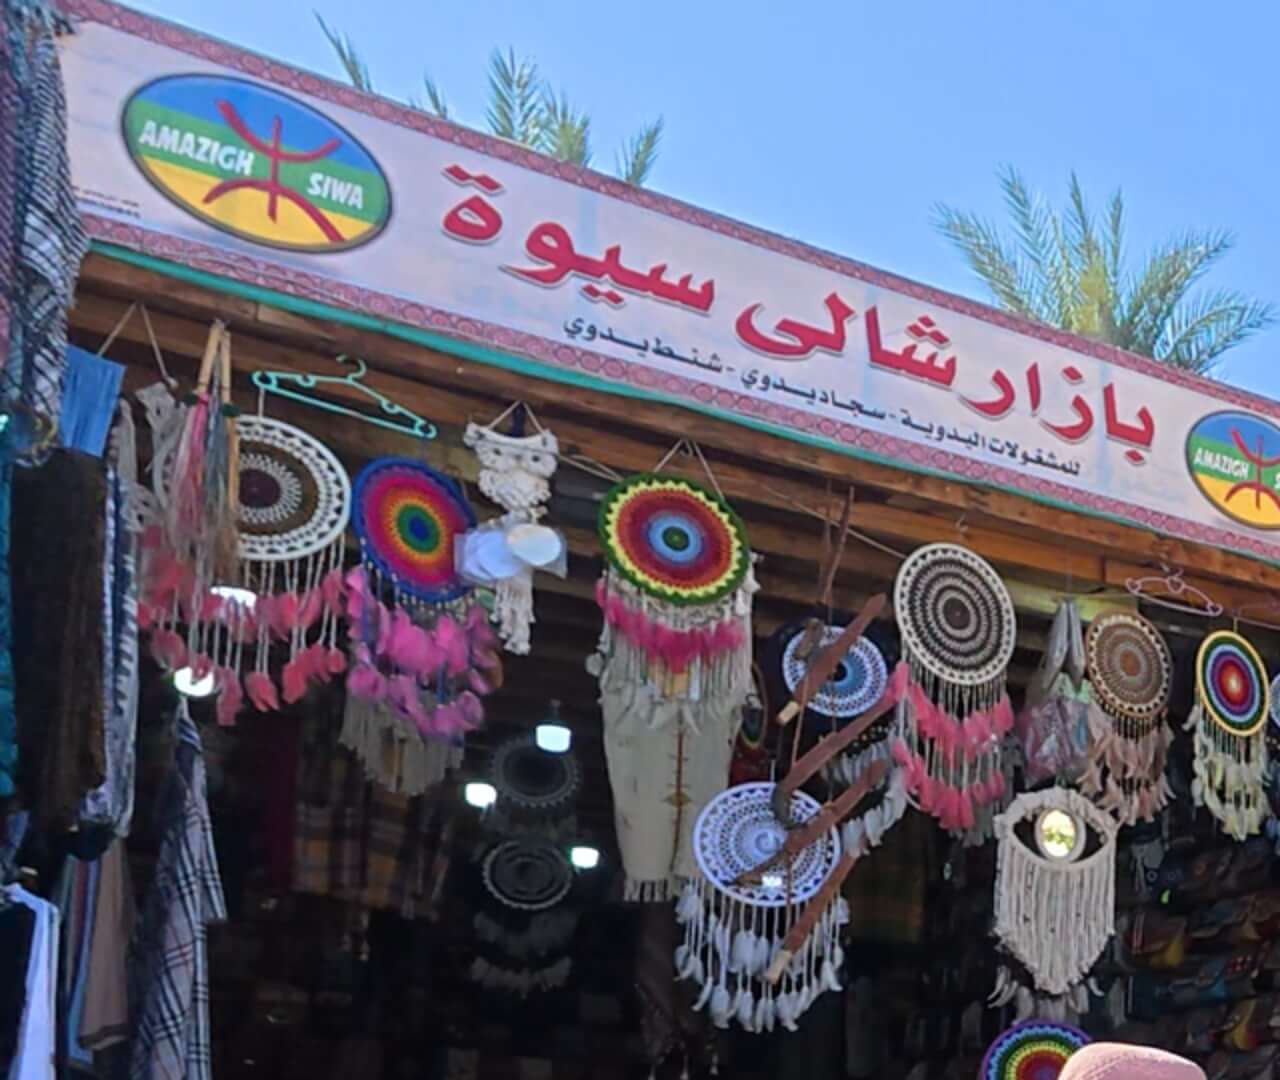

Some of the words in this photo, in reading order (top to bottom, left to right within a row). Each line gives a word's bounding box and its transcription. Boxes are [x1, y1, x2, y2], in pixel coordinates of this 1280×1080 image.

[138, 119, 254, 176] AMAZIGH
[307, 172, 364, 211] SIWA
[440, 163, 715, 313] سيوة
[957, 361, 1155, 465] بازار
[1193, 447, 1250, 481] AMAZIGH
